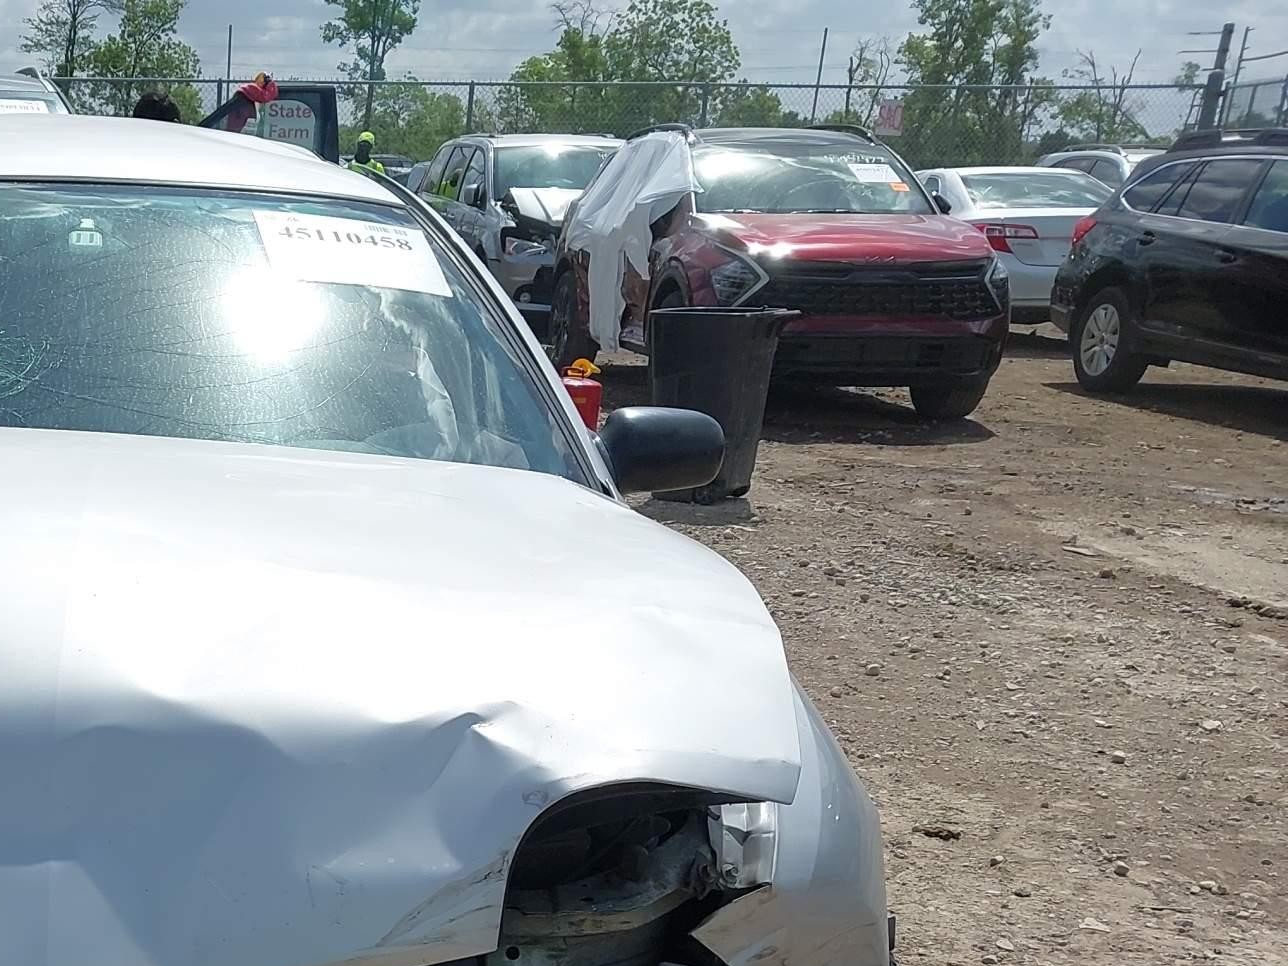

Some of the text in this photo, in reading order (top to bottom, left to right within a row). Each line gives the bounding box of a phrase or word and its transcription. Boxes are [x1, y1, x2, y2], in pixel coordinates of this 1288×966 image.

[268, 103, 313, 119] State
[268, 124, 309, 139] Farm
[278, 226, 413, 252] 45110458
